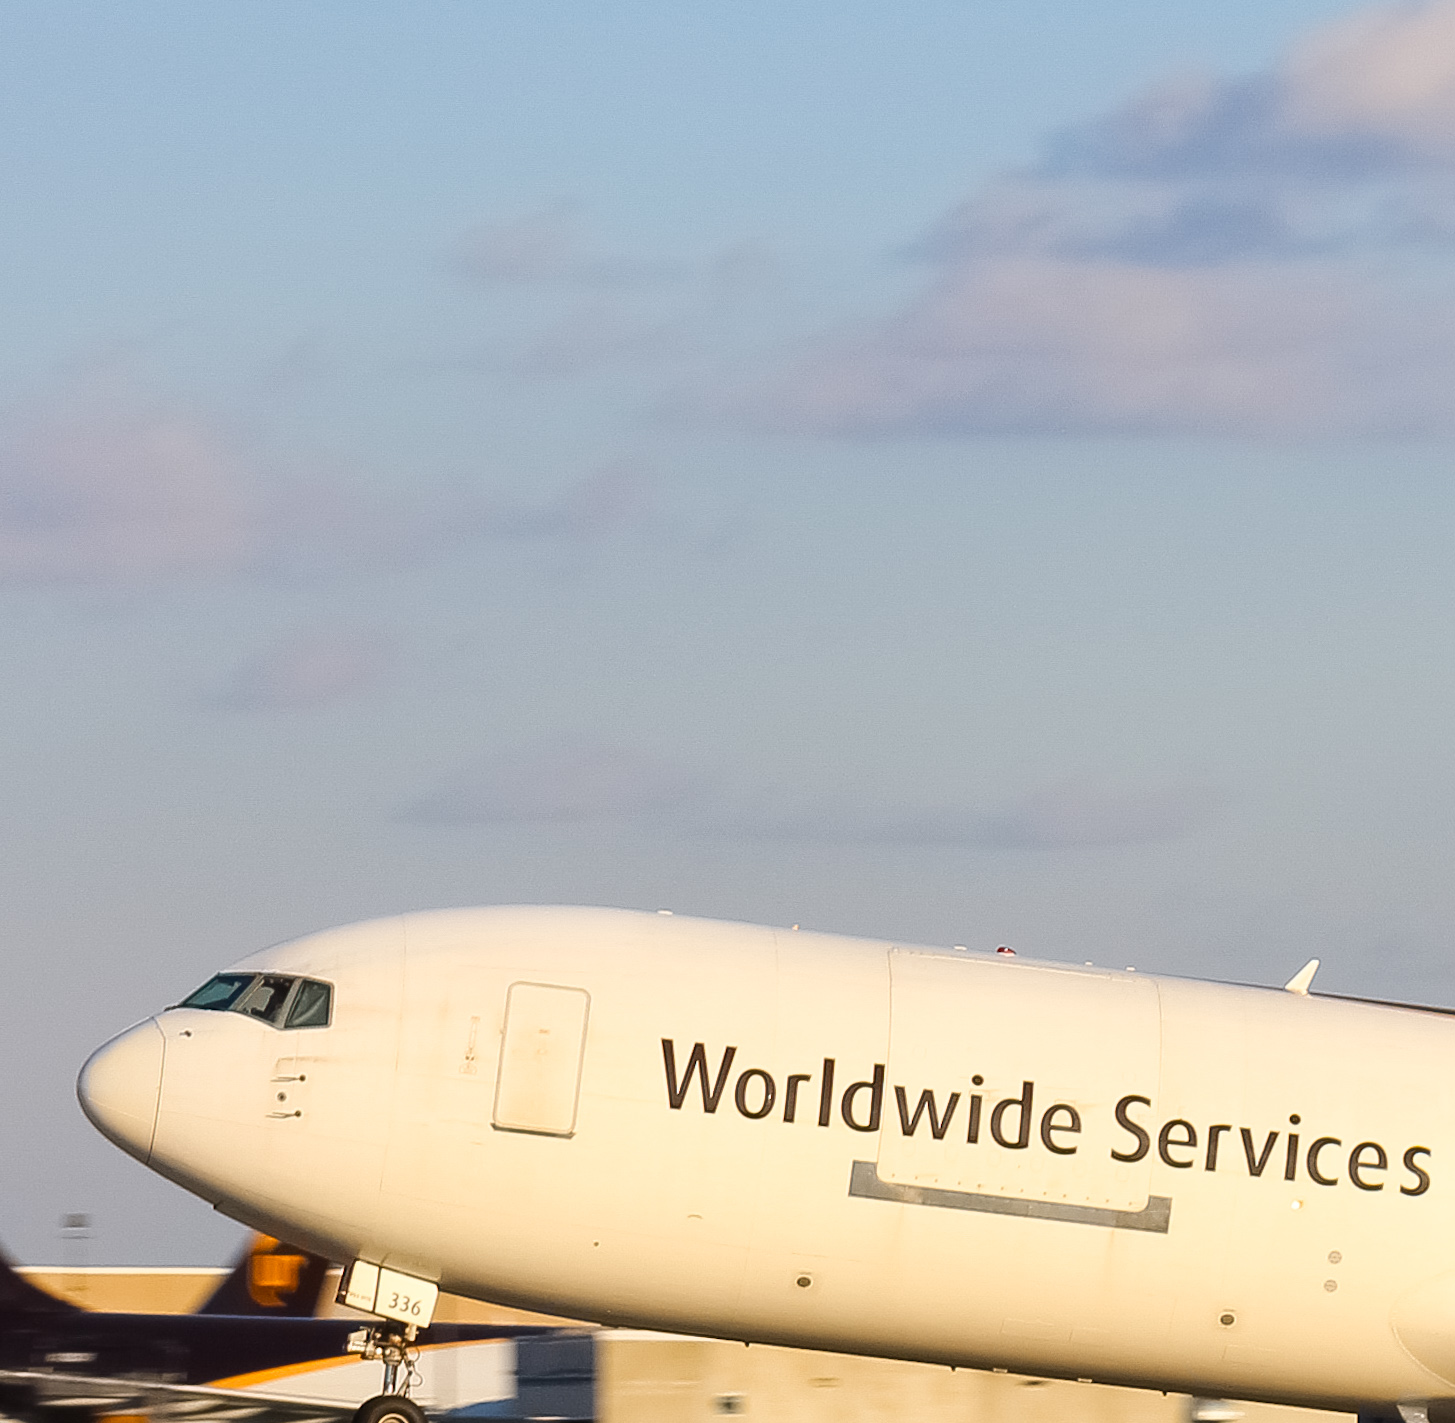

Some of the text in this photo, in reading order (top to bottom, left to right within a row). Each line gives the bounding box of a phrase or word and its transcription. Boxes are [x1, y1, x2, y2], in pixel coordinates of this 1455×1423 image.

[660, 1038, 1432, 1197] Worldwide Services
[388, 1292, 421, 1316] 336
